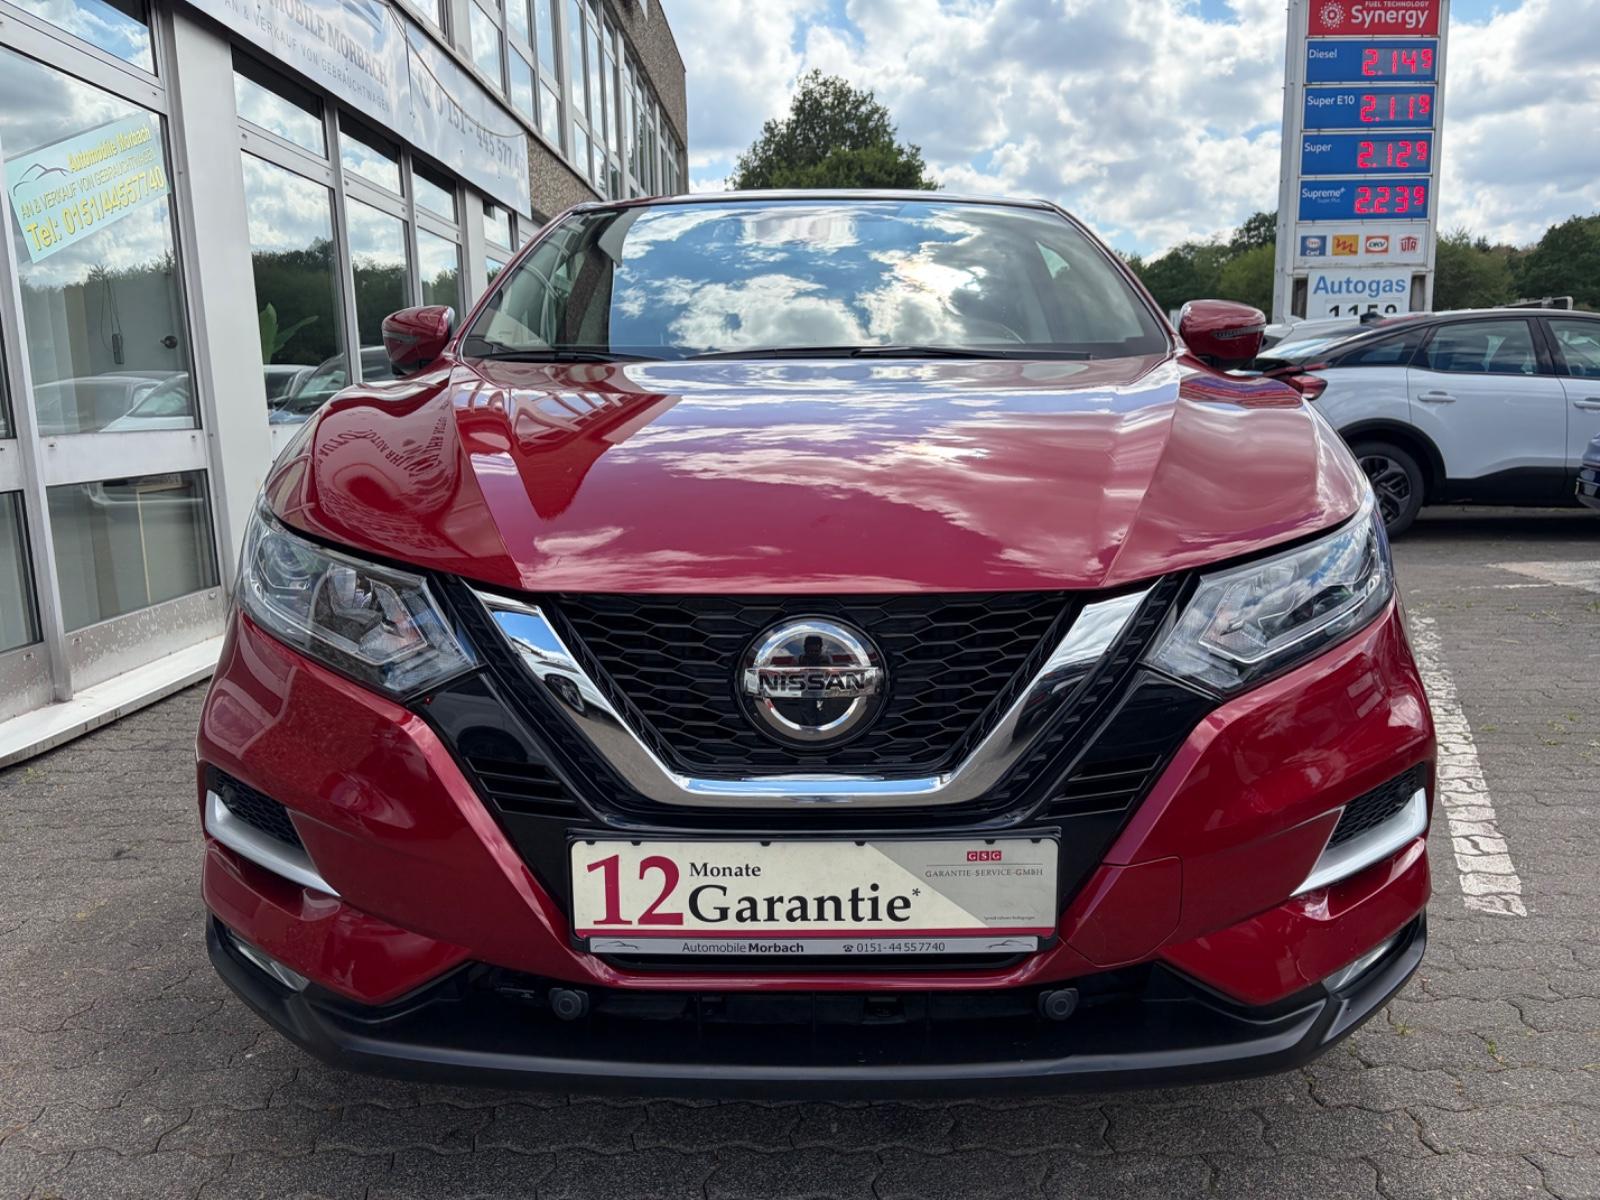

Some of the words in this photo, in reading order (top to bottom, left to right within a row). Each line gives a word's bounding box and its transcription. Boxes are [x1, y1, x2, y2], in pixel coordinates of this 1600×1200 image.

[1351, 5, 1429, 29] Synergy
[254, 13, 297, 50] VERKAUF
[300, 43, 319, 67] VON
[326, 20, 389, 88] MORBACH
[1308, 49, 1337, 58] Diesel
[1362, 48, 1433, 76] 2.149
[1307, 96, 1335, 107] Super
[1337, 95, 1355, 105] E10
[1360, 94, 1431, 122] 2.119
[1304, 142, 1332, 153] Super
[1357, 141, 1428, 169] 2.129
[1354, 186, 1425, 214] 2.239
[26, 215, 63, 252] Tel:
[1400, 237, 1418, 252] UTA
[1313, 275, 1406, 298] Autogas
[759, 672, 865, 691] NISSAN
[689, 861, 761, 877] Monate
[586, 854, 684, 926] 12
